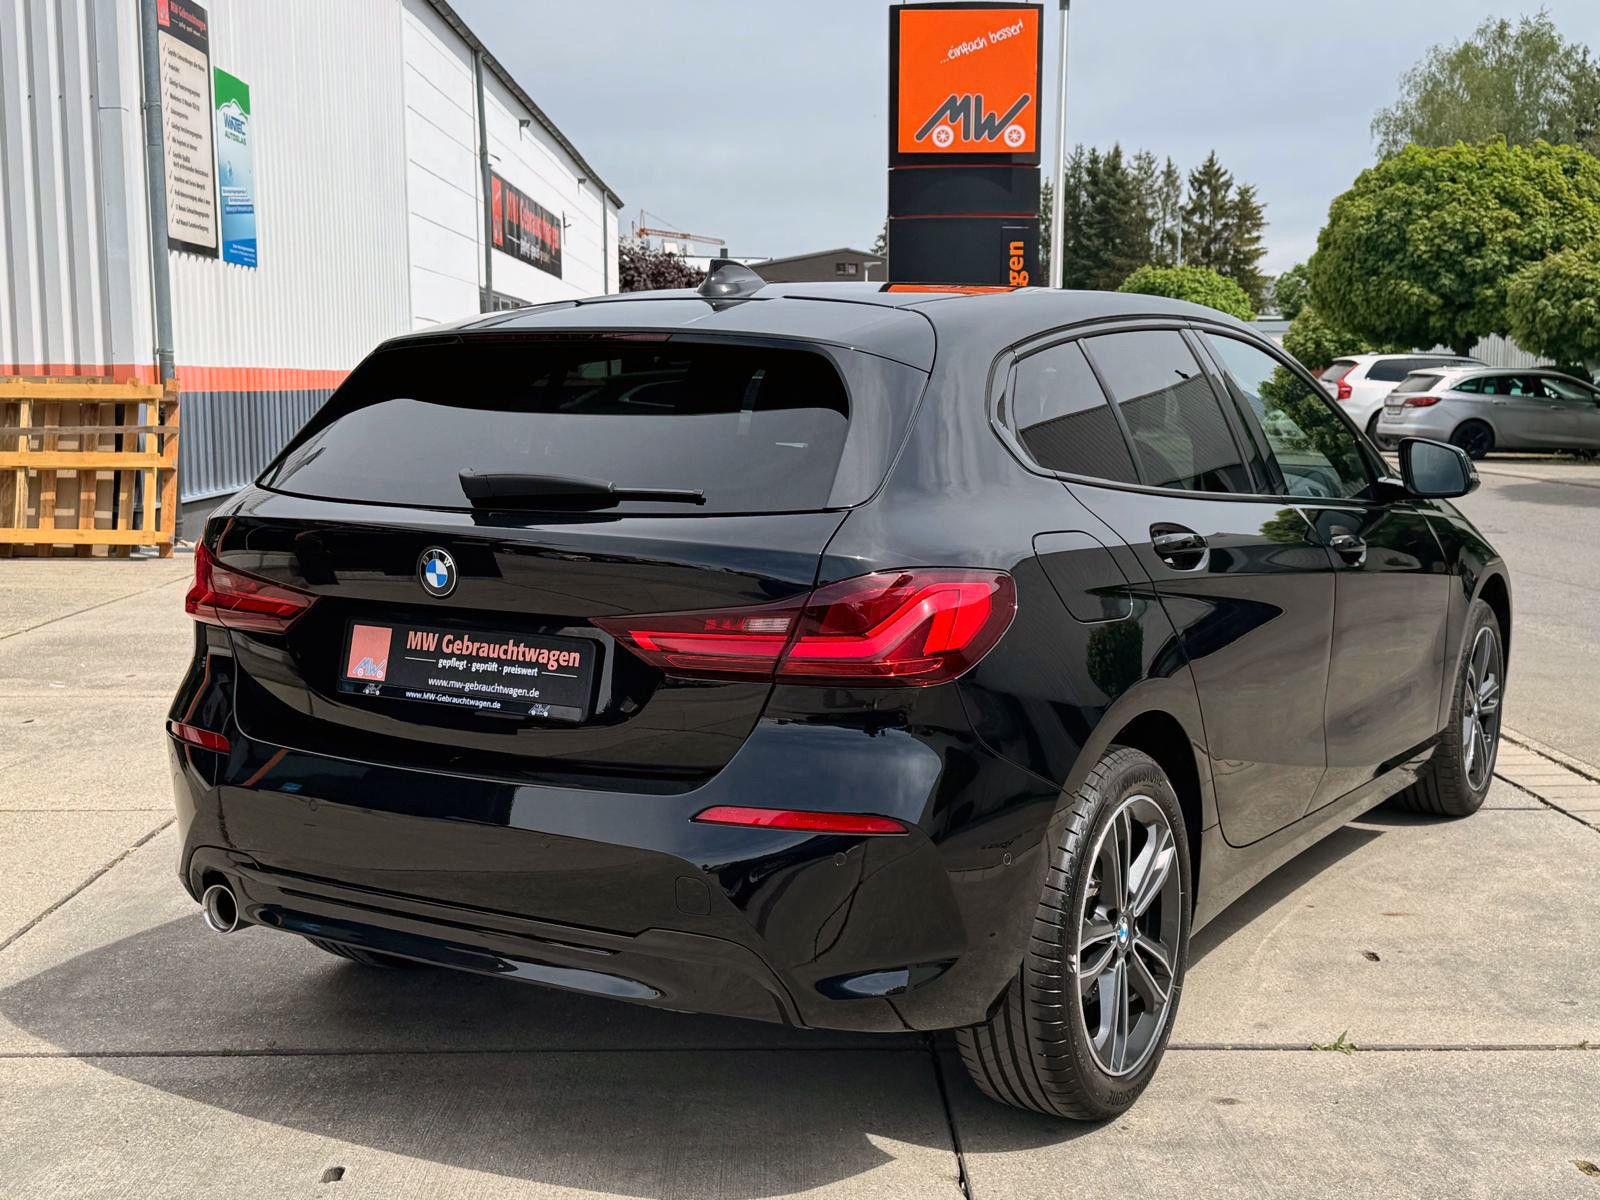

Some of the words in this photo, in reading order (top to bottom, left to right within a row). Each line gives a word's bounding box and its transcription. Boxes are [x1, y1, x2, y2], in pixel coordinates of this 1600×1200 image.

[914, 93, 1031, 143] MW
[422, 551, 452, 568] BMW
[407, 630, 439, 652] MW
[442, 634, 581, 670] Gebrauchtwagen
[438, 657, 467, 670] gepflegt
[471, 661, 499, 673] geprüft
[502, 664, 539, 677] preiswert
[428, 677, 540, 698] www.mw-gebrauchtwagen.de
[405, 690, 501, 709] www.MW-Gebrauchtwagen.de
